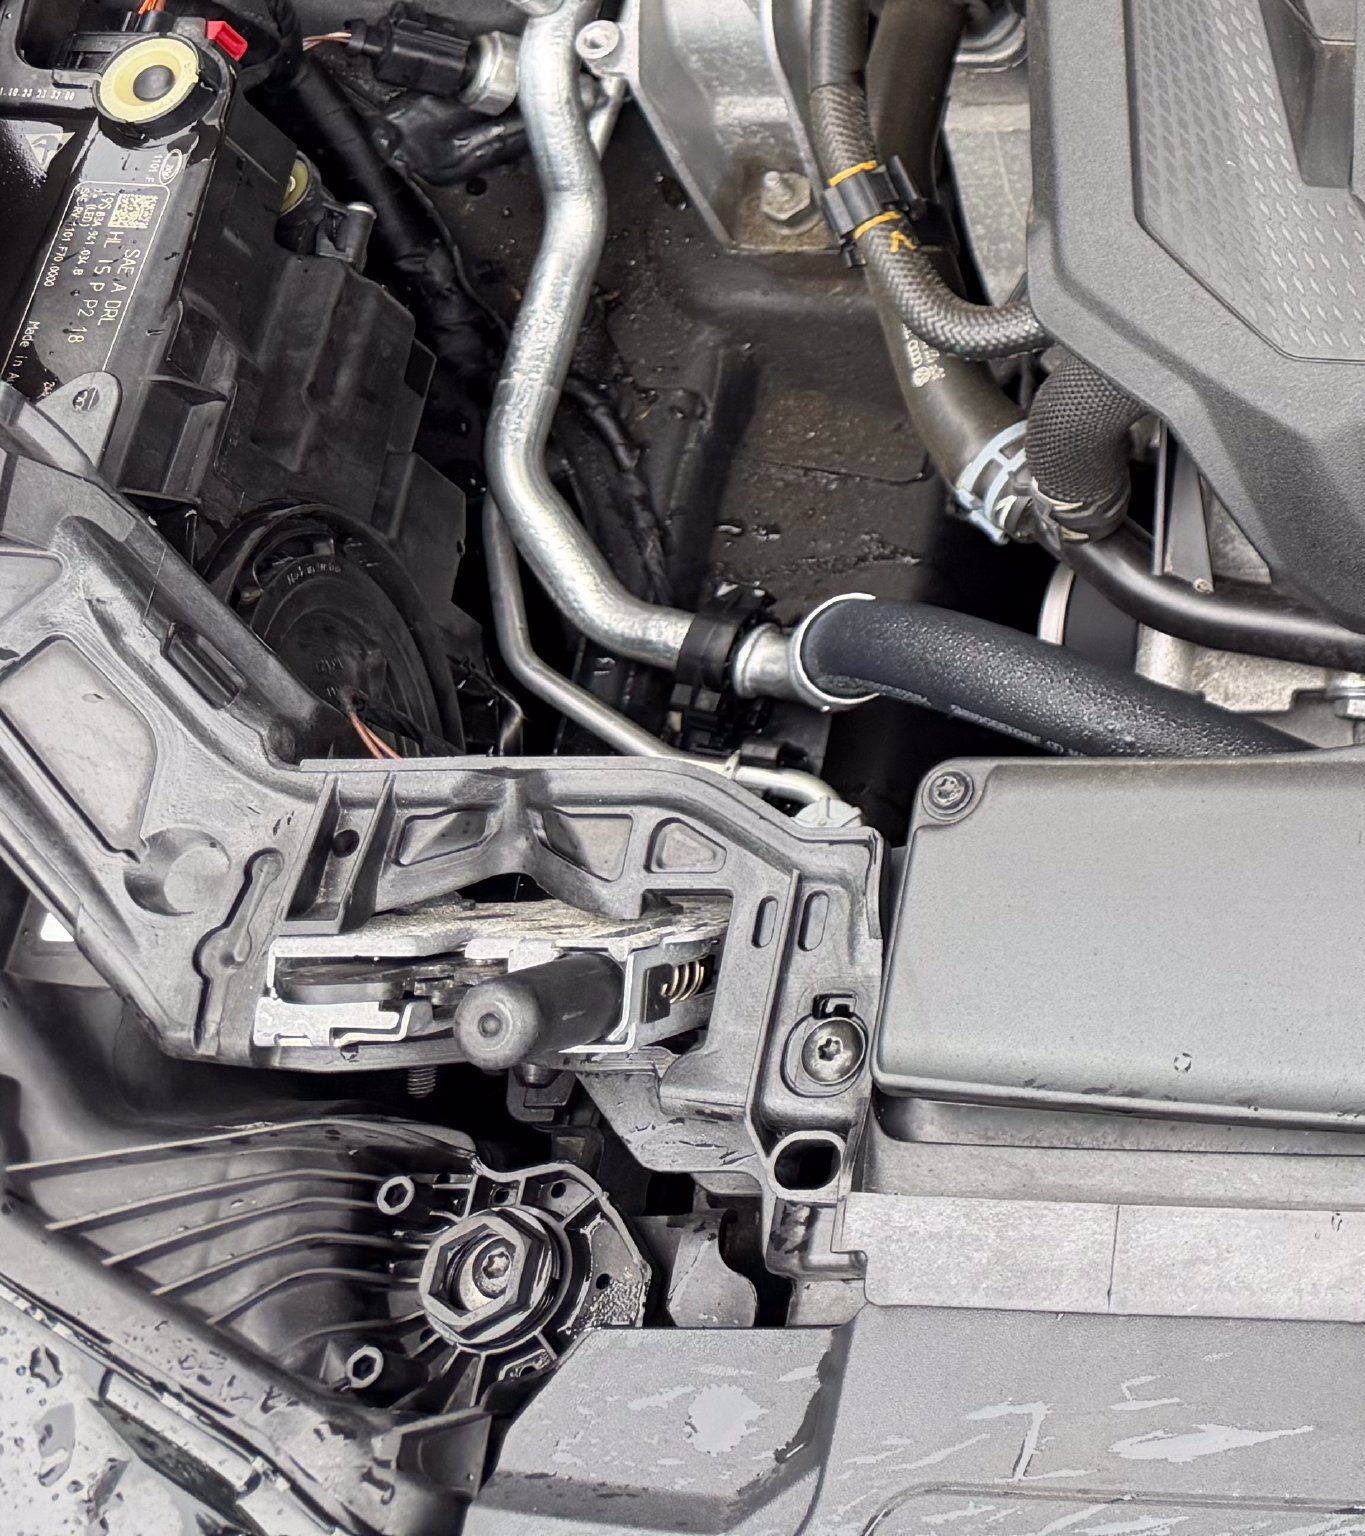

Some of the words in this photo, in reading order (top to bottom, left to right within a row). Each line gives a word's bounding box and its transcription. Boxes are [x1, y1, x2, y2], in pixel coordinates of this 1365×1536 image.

[103, 231, 124, 248] HL
[117, 249, 141, 275] SAE
[89, 282, 105, 292] P
[110, 282, 127, 293] A
[77, 299, 98, 317] P2
[97, 300, 122, 326] DRL
[20, 321, 40, 348] Made
[67, 327, 88, 343] 18
[13, 355, 28, 367] in
